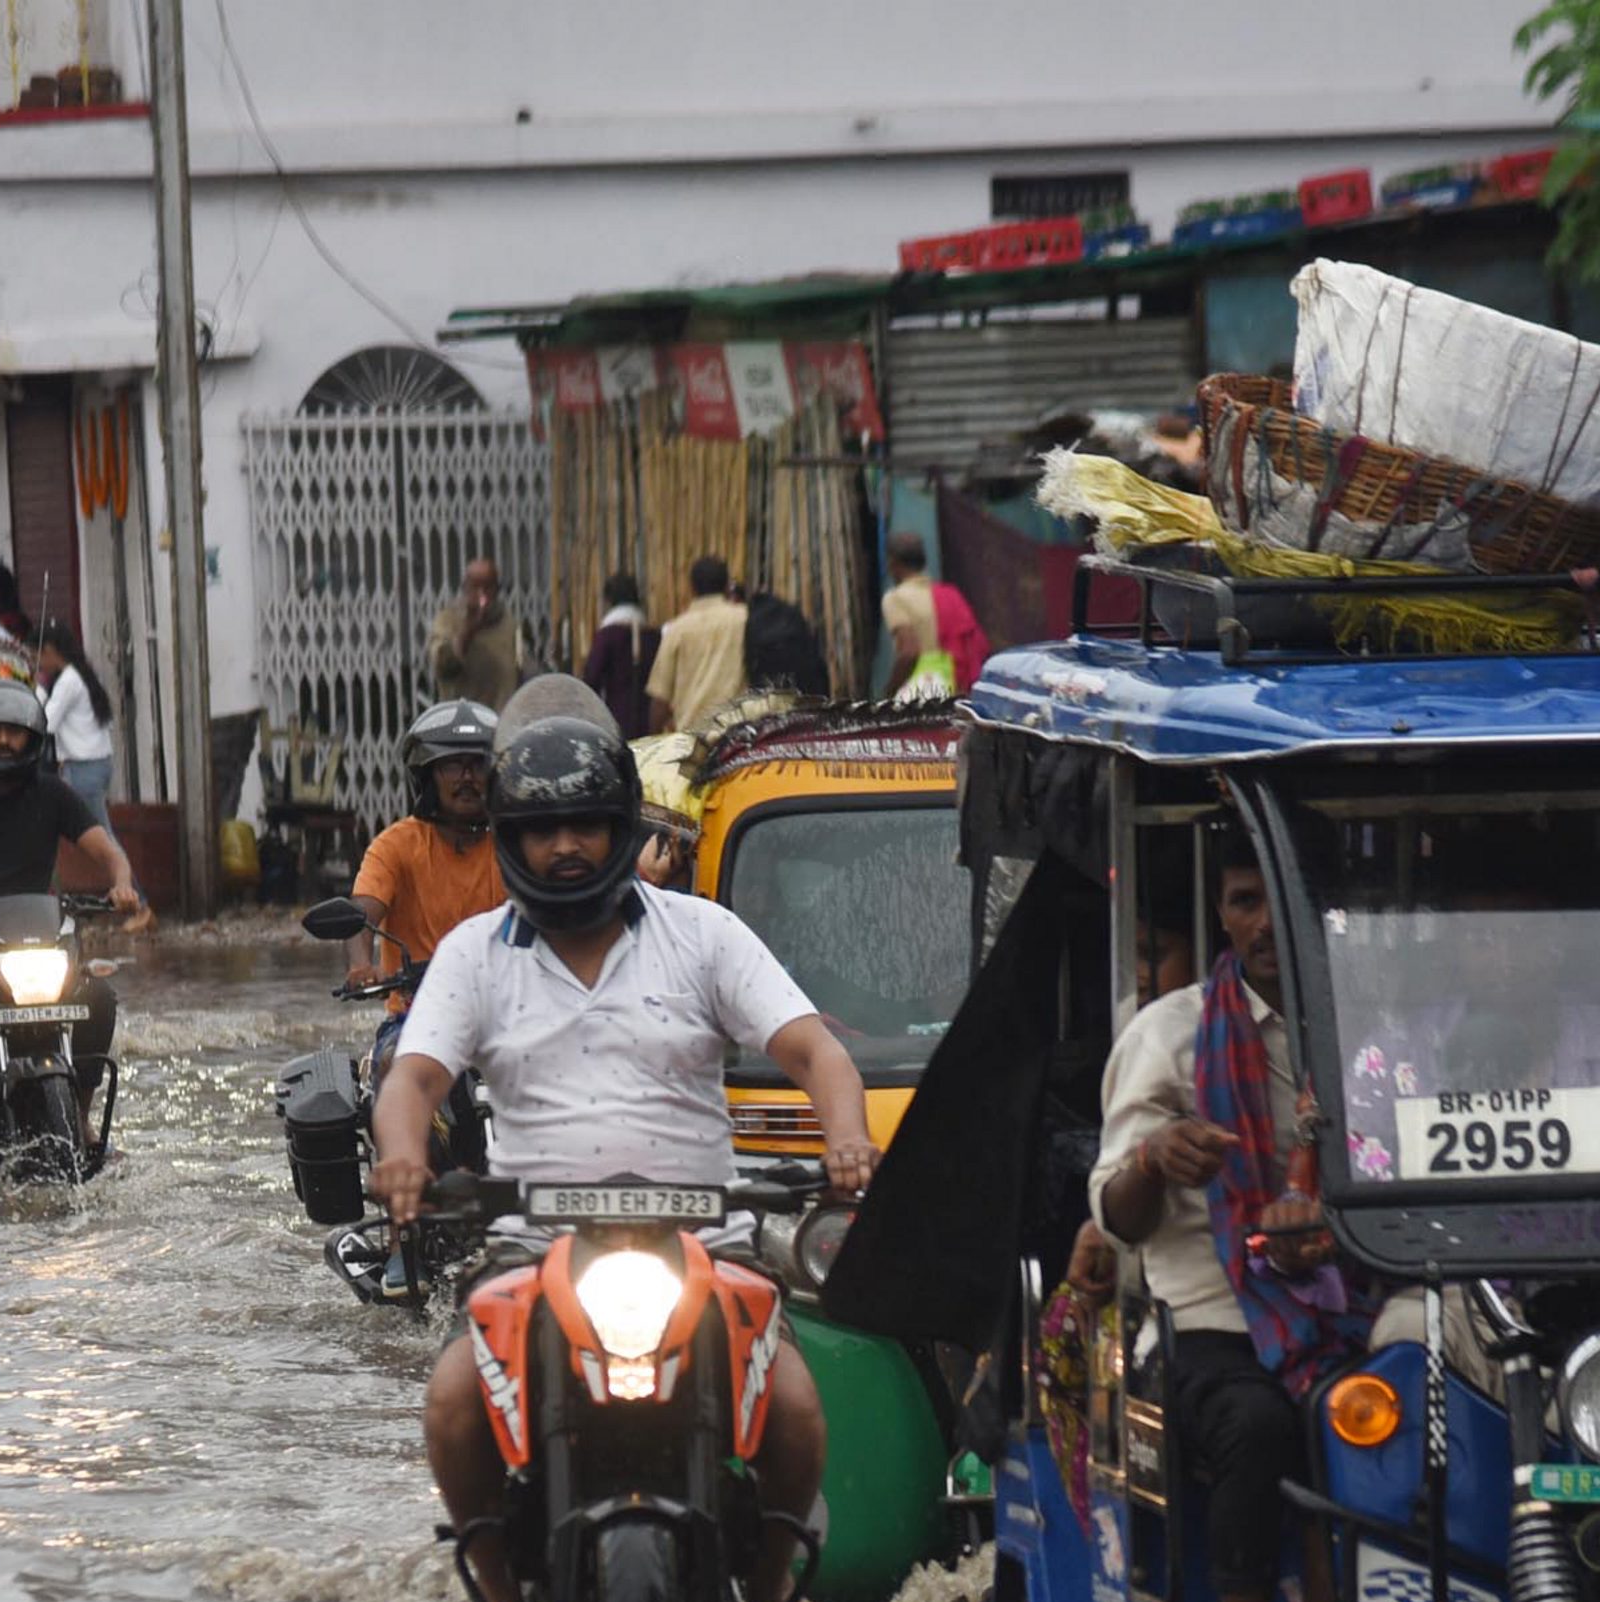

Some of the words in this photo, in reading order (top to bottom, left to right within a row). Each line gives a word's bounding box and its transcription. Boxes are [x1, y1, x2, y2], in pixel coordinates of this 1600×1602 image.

[1438, 1088, 1551, 1114] BR-01PP
[1427, 1118, 1572, 1172] 2959
[619, 1191, 648, 1213] EH
[655, 1191, 713, 1213] 7823
